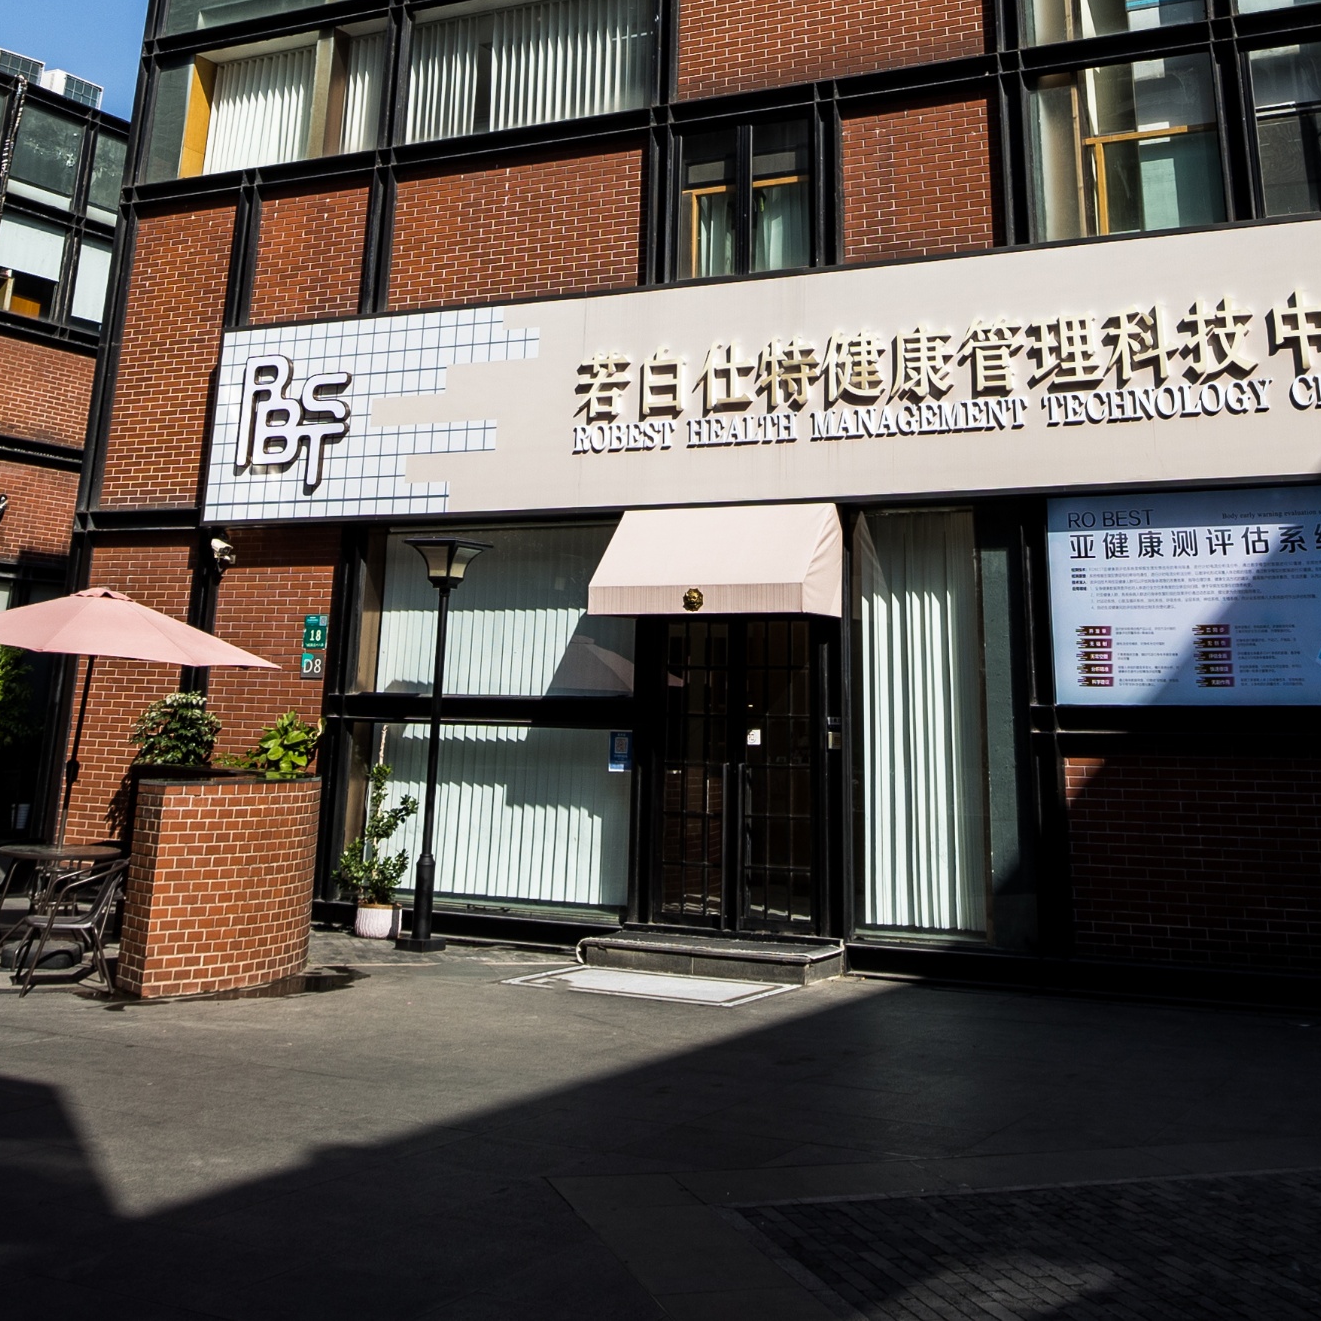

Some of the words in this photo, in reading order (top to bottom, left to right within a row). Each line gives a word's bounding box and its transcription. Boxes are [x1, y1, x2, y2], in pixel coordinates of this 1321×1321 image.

[574, 421, 675, 454] ROBEST
[687, 411, 797, 447] HEALTH
[811, 395, 1027, 441] MANAGEMENT
[1042, 378, 1272, 428] TECHNOLOGY
[1068, 511, 1096, 528] RO
[1102, 509, 1153, 527] BEST
[1222, 512, 1237, 520] Body
[1240, 512, 1255, 520] early
[1258, 510, 1282, 518] warning
[1284, 509, 1316, 517] evaluation
[309, 629, 322, 642] 18
[303, 658, 322, 673] D8
